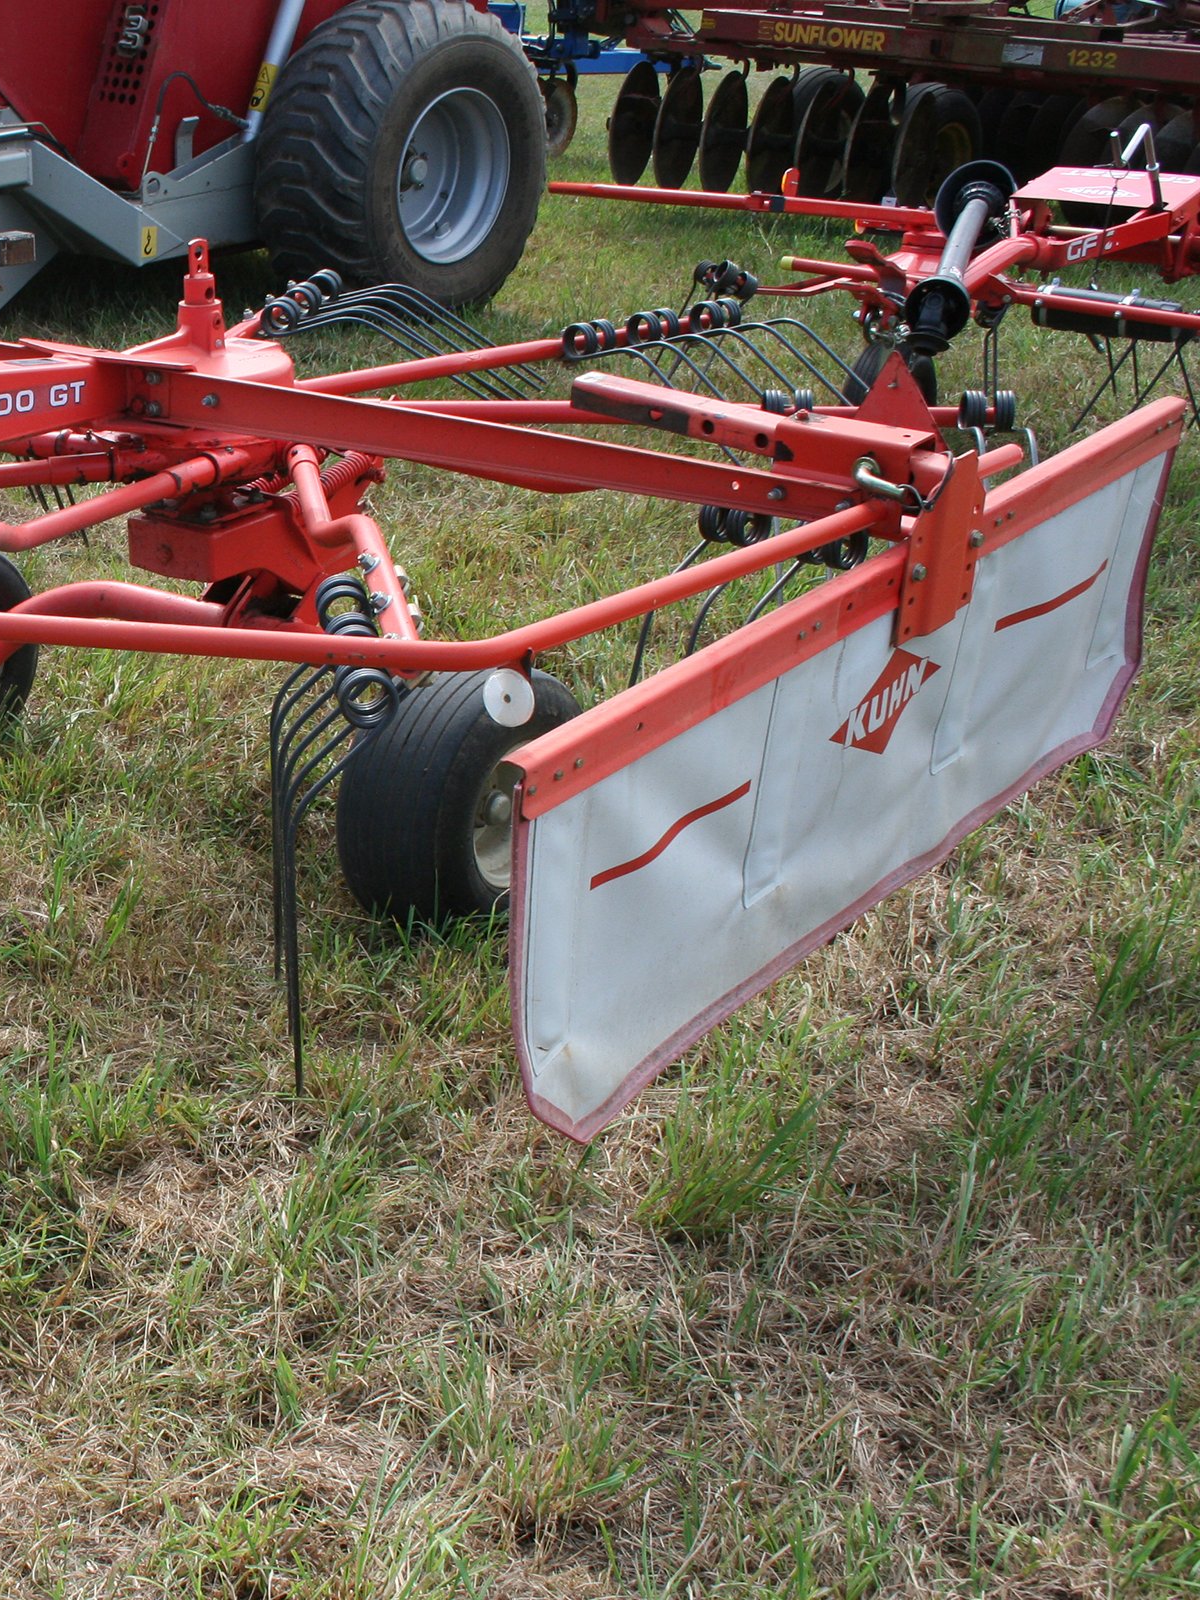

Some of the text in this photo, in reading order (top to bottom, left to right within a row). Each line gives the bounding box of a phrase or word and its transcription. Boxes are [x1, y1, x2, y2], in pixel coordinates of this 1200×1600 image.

[774, 21, 885, 51] SUNFLOWER
[1067, 49, 1118, 69] 1232
[1067, 235, 1098, 261] GF
[49, 381, 86, 407] GT
[842, 656, 930, 750] KUHN
